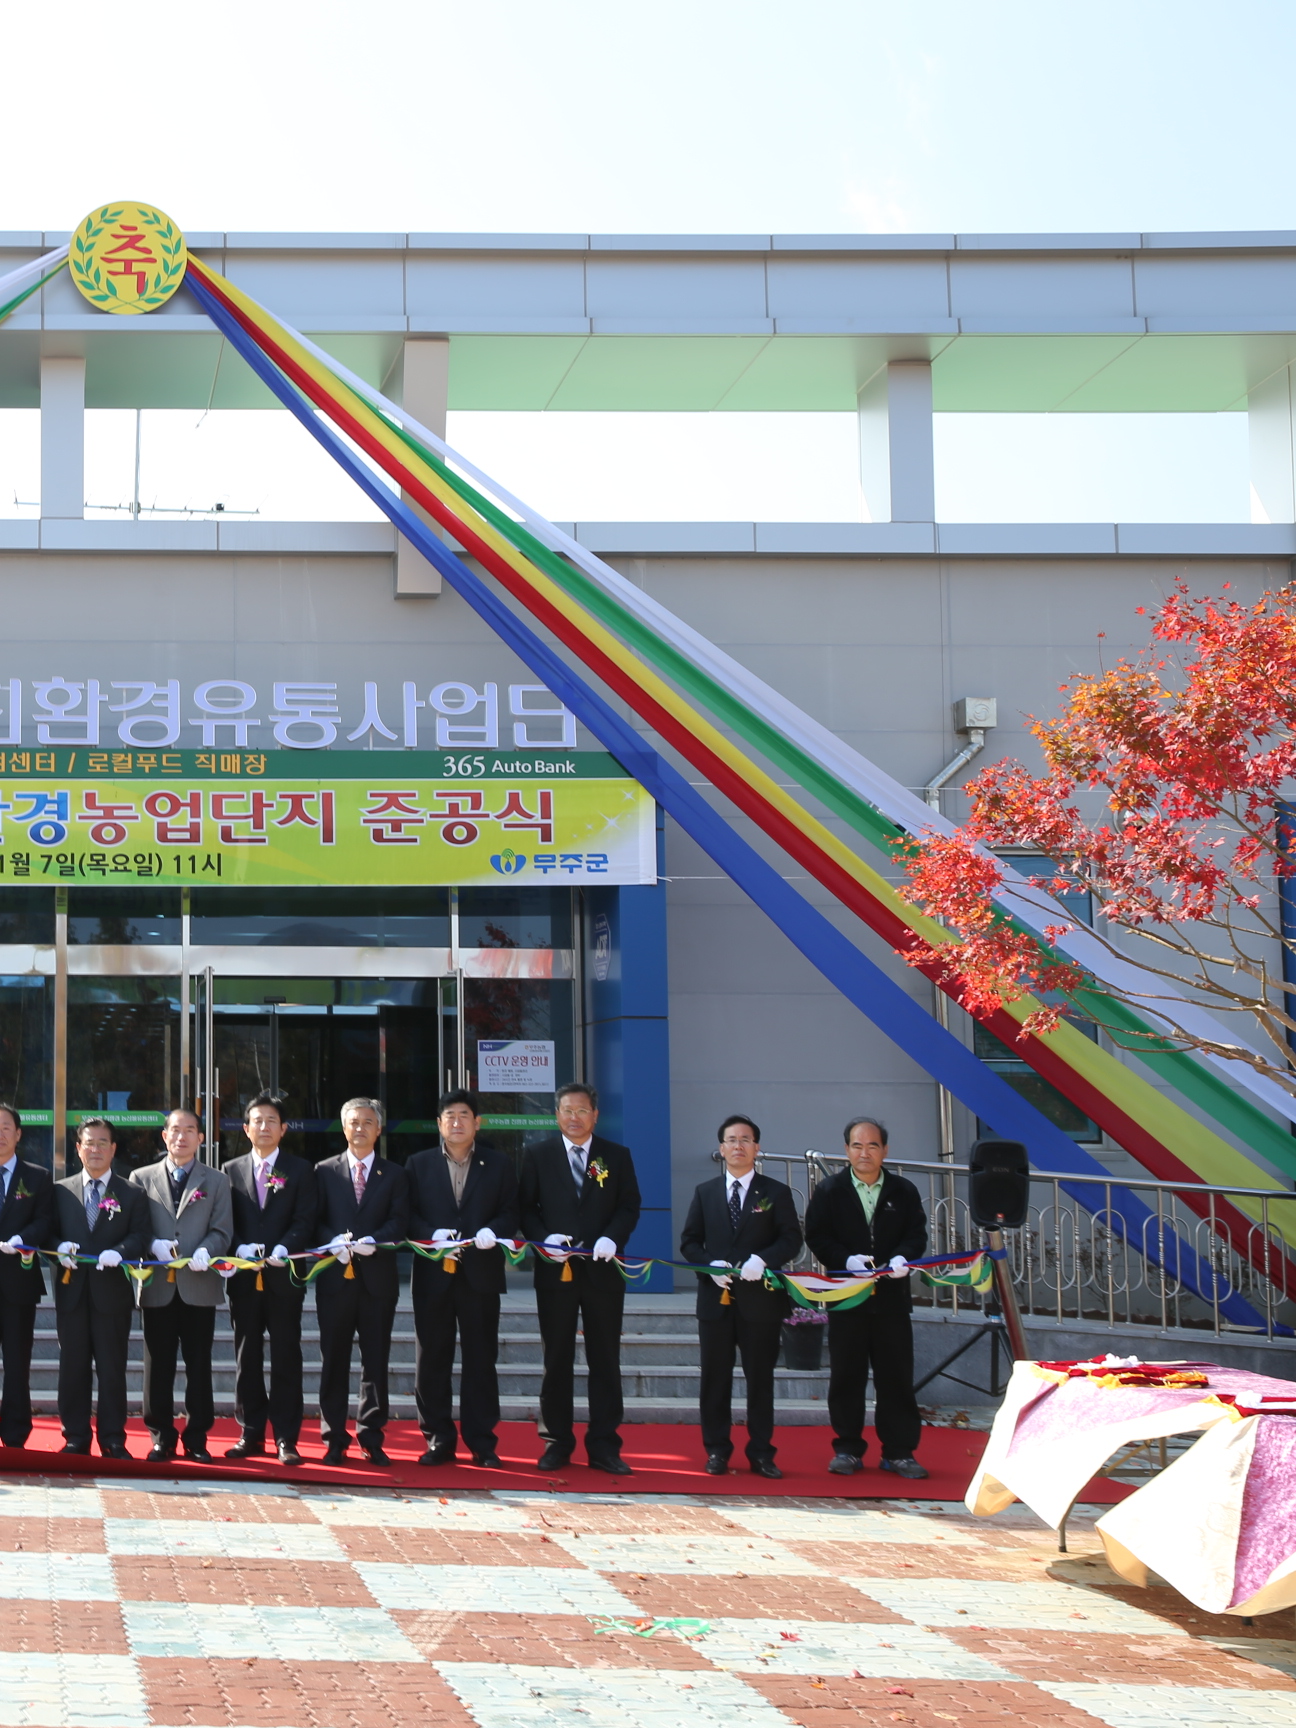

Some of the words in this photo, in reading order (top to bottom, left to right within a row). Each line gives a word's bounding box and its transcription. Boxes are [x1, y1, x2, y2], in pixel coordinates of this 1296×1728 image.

[100, 224, 158, 295] 축
[87, 752, 183, 774] 로컬푸드
[195, 752, 268, 775] 직매장
[442, 754, 486, 778] 365
[492, 760, 532, 774] Auto
[535, 760, 576, 774] Bank
[359, 789, 554, 846] 준공식
[40, 852, 163, 877] 7일(목요일)
[173, 853, 223, 877] 11시
[533, 853, 609, 874] 무주군
[484, 1055, 509, 1067] CCTV
[511, 1055, 529, 1067] 운영
[531, 1055, 549, 1067] 안내
